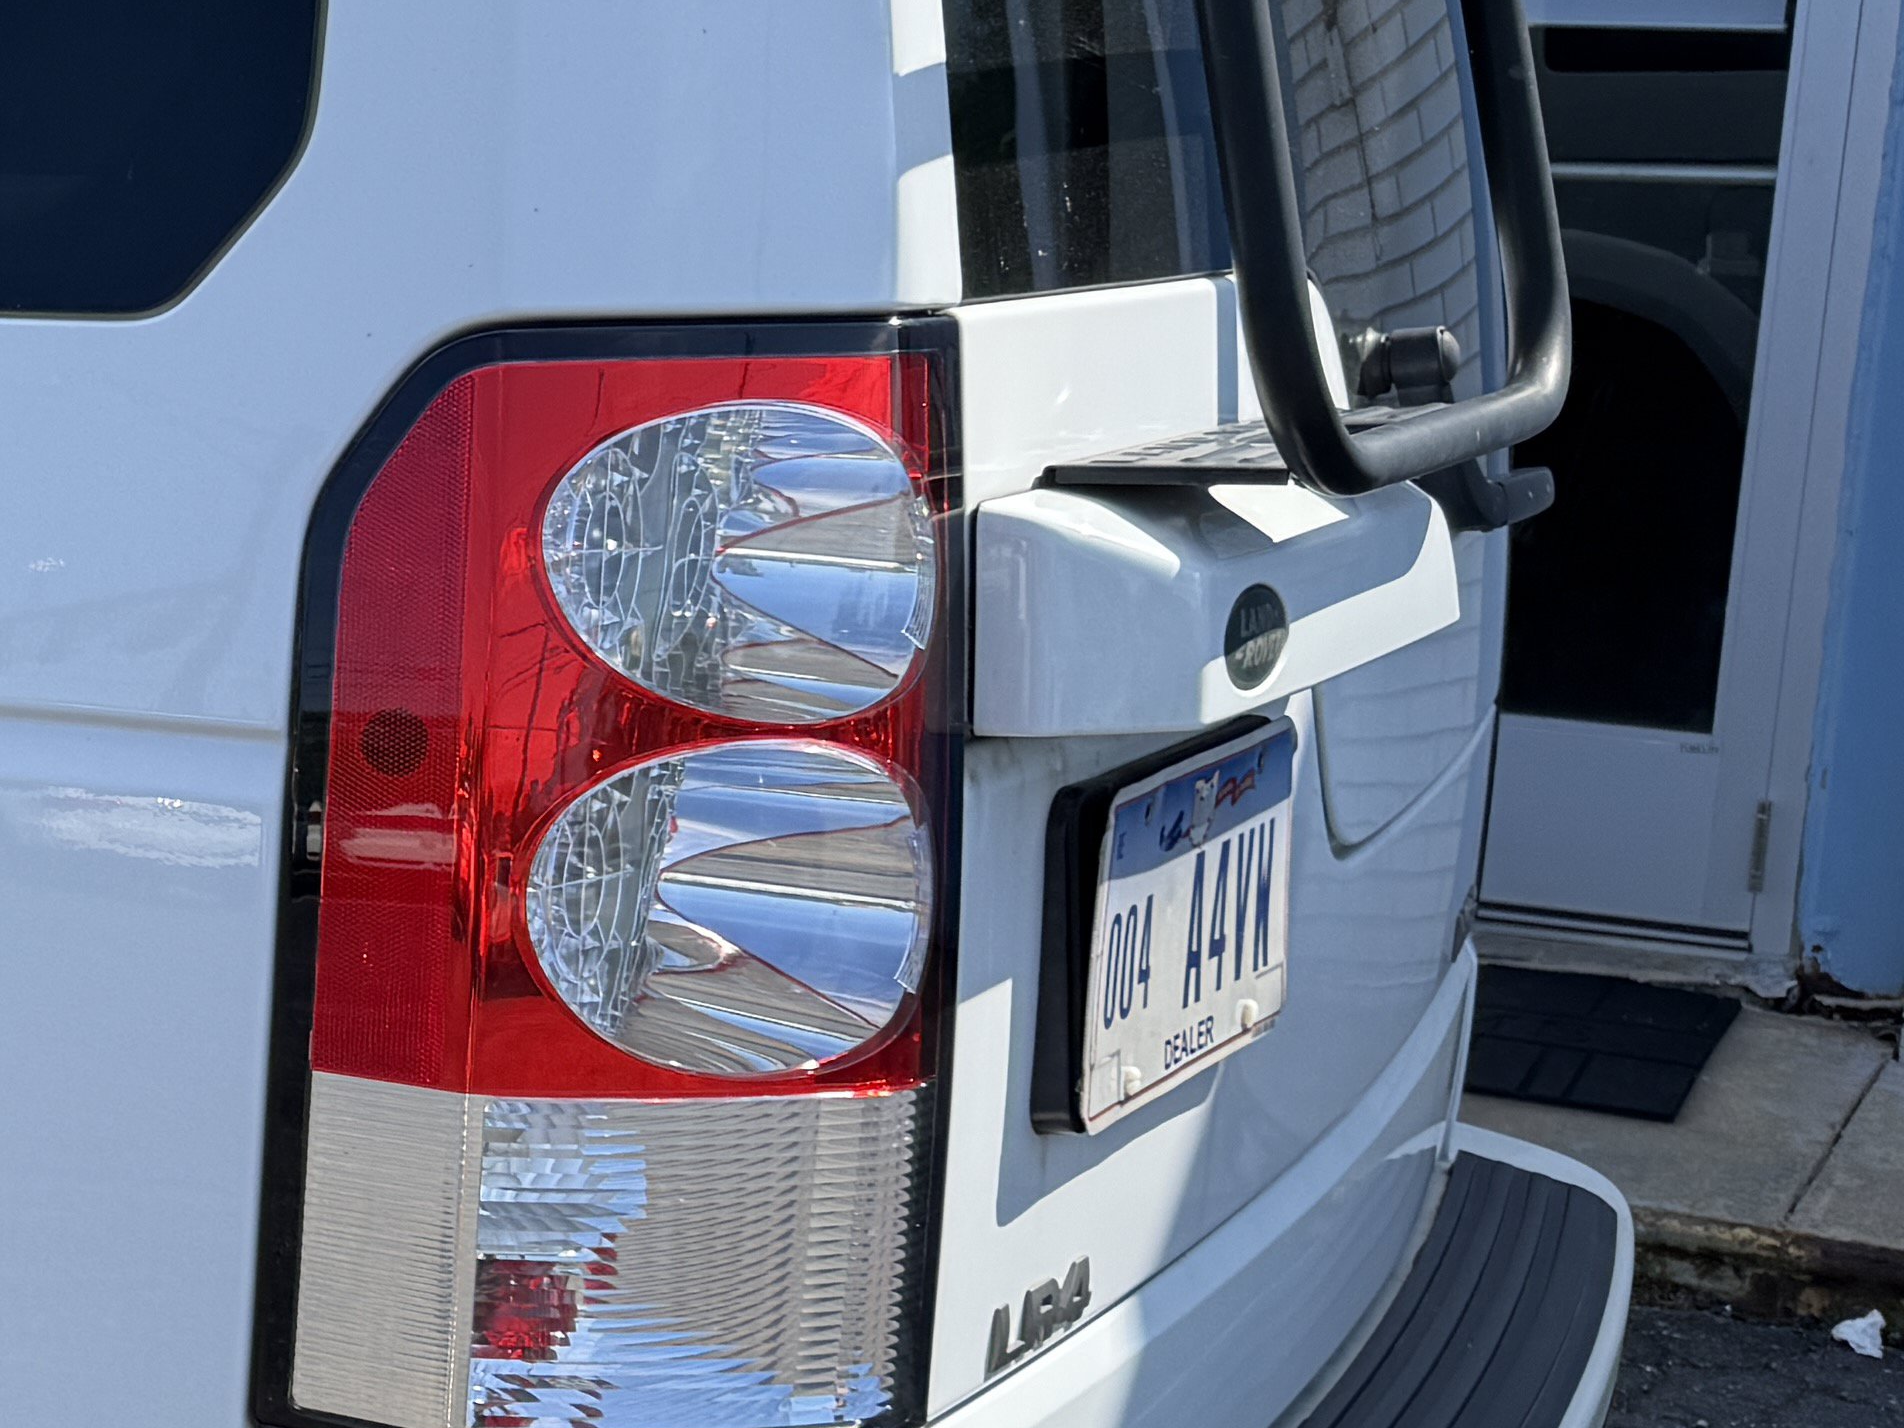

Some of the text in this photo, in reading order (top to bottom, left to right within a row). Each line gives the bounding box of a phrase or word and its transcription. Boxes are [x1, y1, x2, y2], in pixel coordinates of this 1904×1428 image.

[1103, 893, 1154, 1030] 004
[1163, 1015, 1215, 1070] DEALER
[985, 1255, 1091, 1374] LR4
